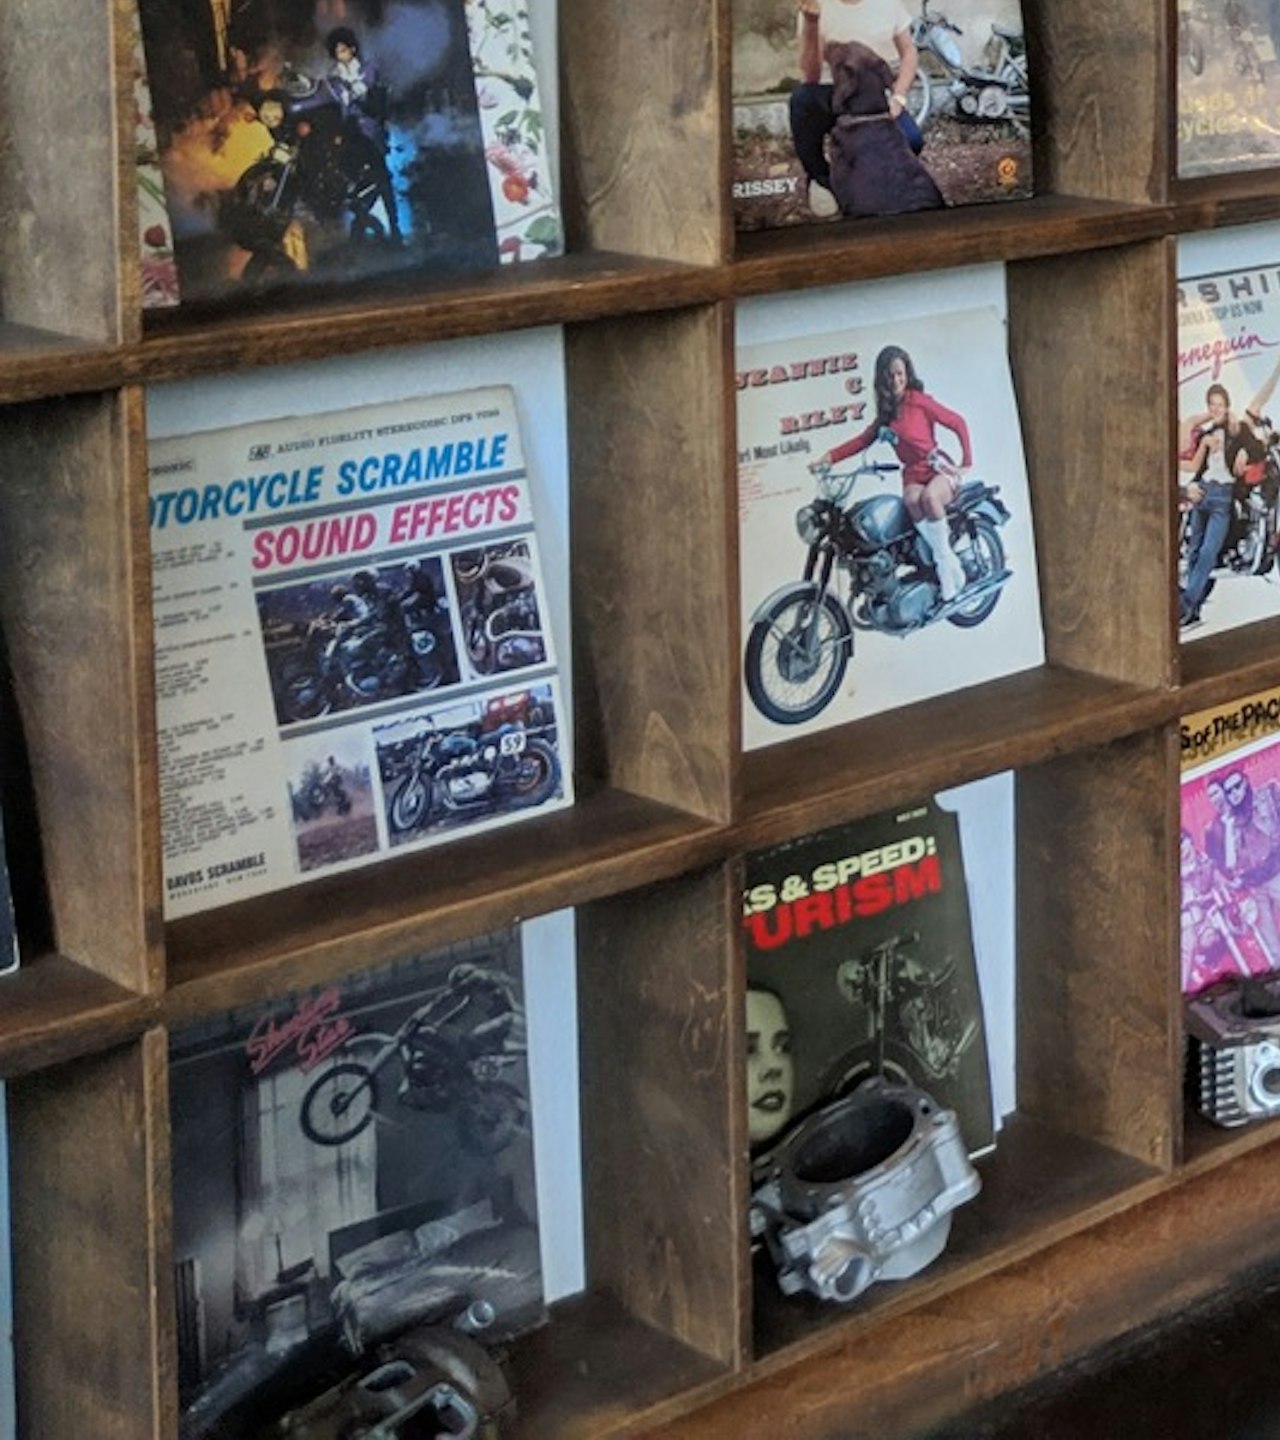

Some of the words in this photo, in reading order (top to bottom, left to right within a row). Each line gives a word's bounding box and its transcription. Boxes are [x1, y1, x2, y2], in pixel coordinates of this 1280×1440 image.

[736, 353, 858, 390] JEANNIE
[779, 402, 867, 436] RILEY
[336, 433, 508, 496] SCRAMBLE
[252, 513, 377, 571] SOUND
[389, 485, 520, 544] EFFECTS
[1212, 710, 1241, 737] THE
[780, 874, 811, 903] &
[811, 835, 937, 893] SPEED:
[743, 854, 942, 951] URISM
